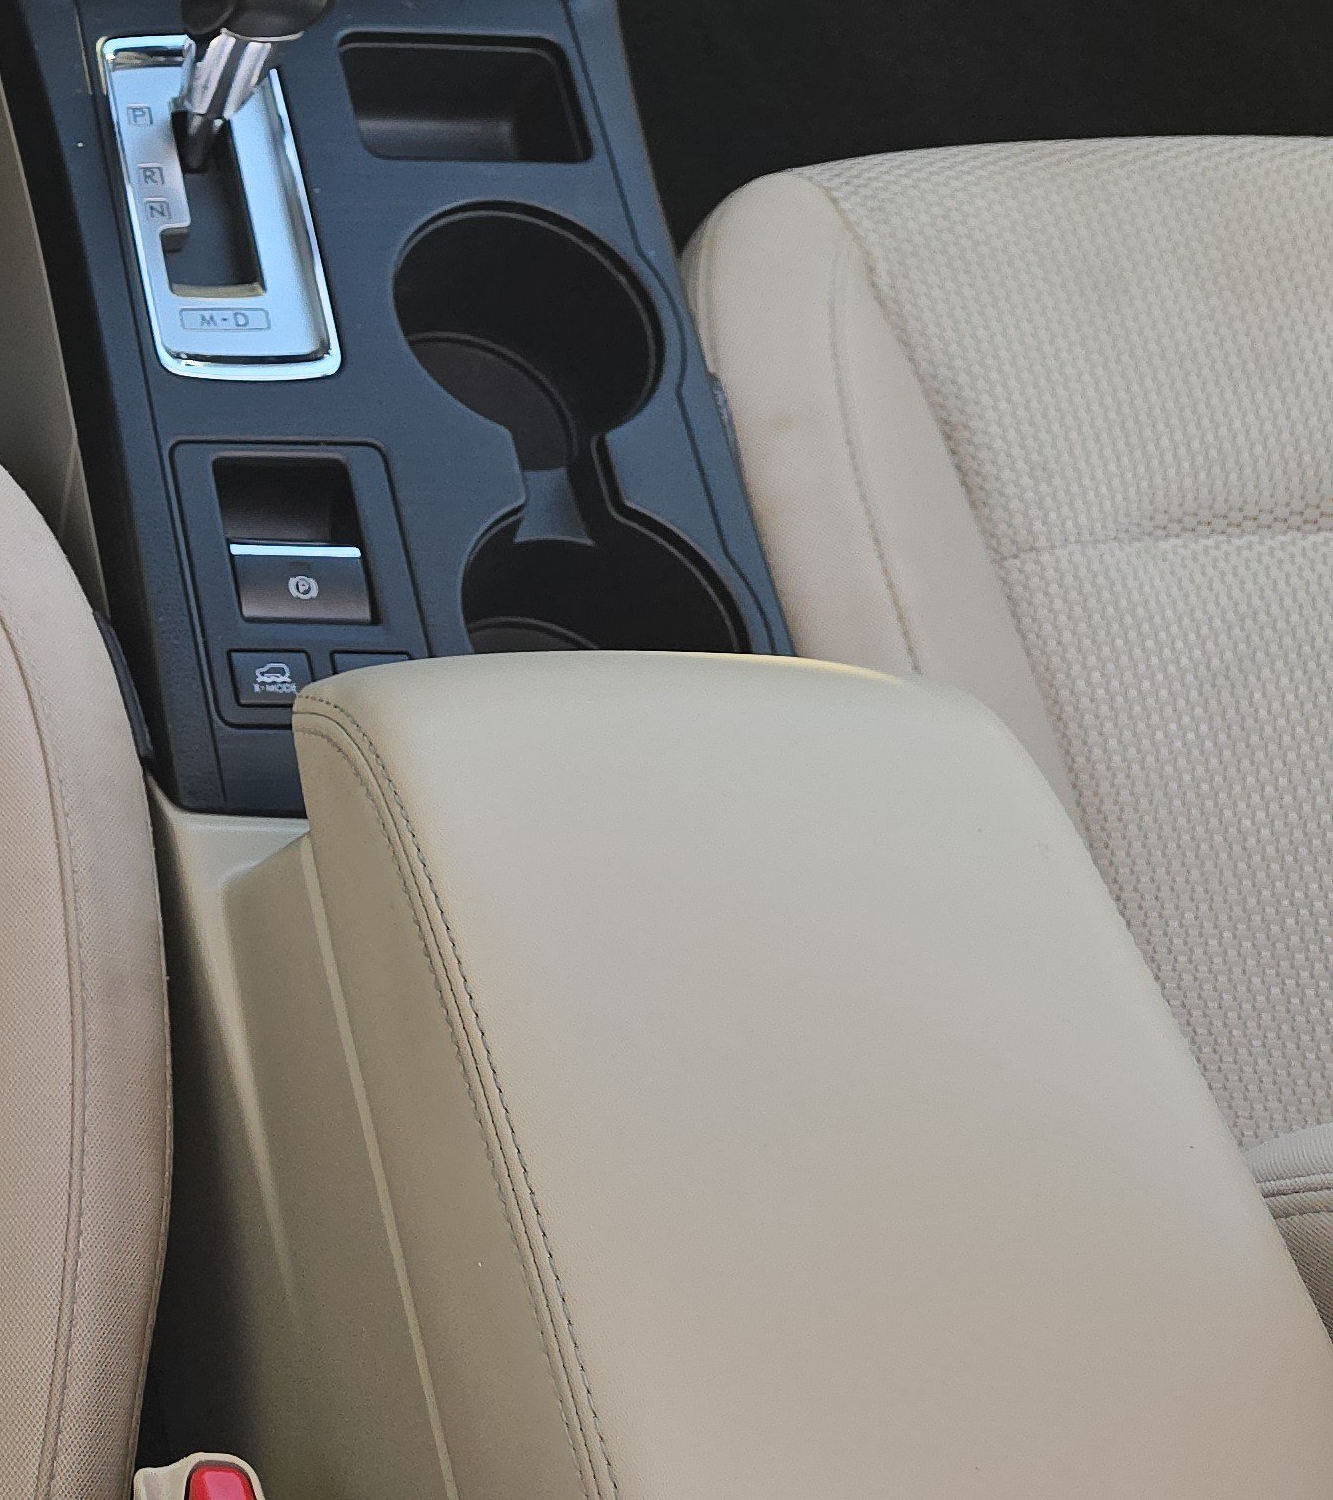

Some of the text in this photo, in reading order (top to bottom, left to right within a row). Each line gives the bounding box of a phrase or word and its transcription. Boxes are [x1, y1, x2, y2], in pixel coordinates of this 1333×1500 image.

[132, 112, 147, 126] P
[142, 168, 157, 184] R
[148, 203, 165, 218] N
